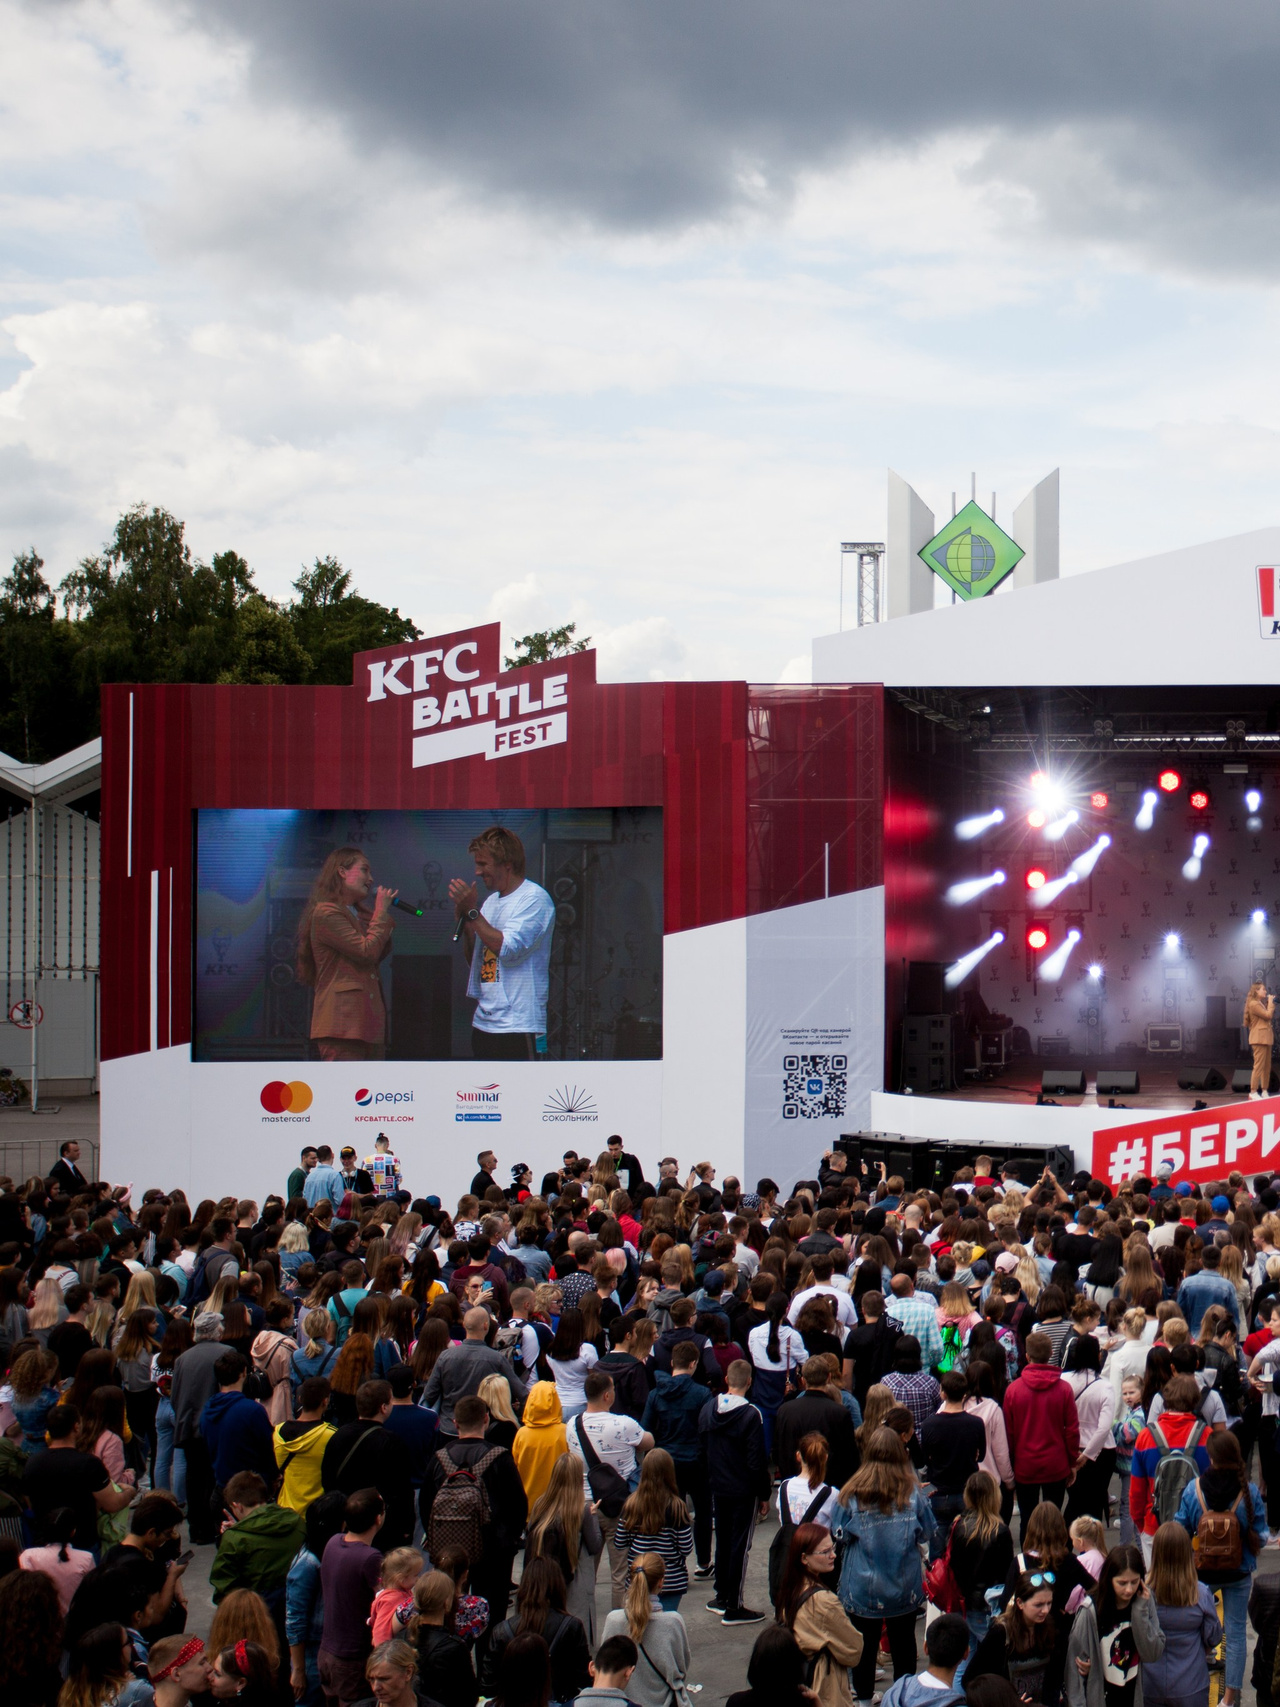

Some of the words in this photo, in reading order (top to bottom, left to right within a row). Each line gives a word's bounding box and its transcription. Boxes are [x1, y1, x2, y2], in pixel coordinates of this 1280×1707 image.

[367, 642, 480, 702] KFC
[413, 673, 568, 730] BATTLE
[495, 722, 552, 752] FEST
[375, 1090, 414, 1104] pepsi
[456, 1090, 502, 1102] Sunmar
[262, 1115, 310, 1123] mastercard
